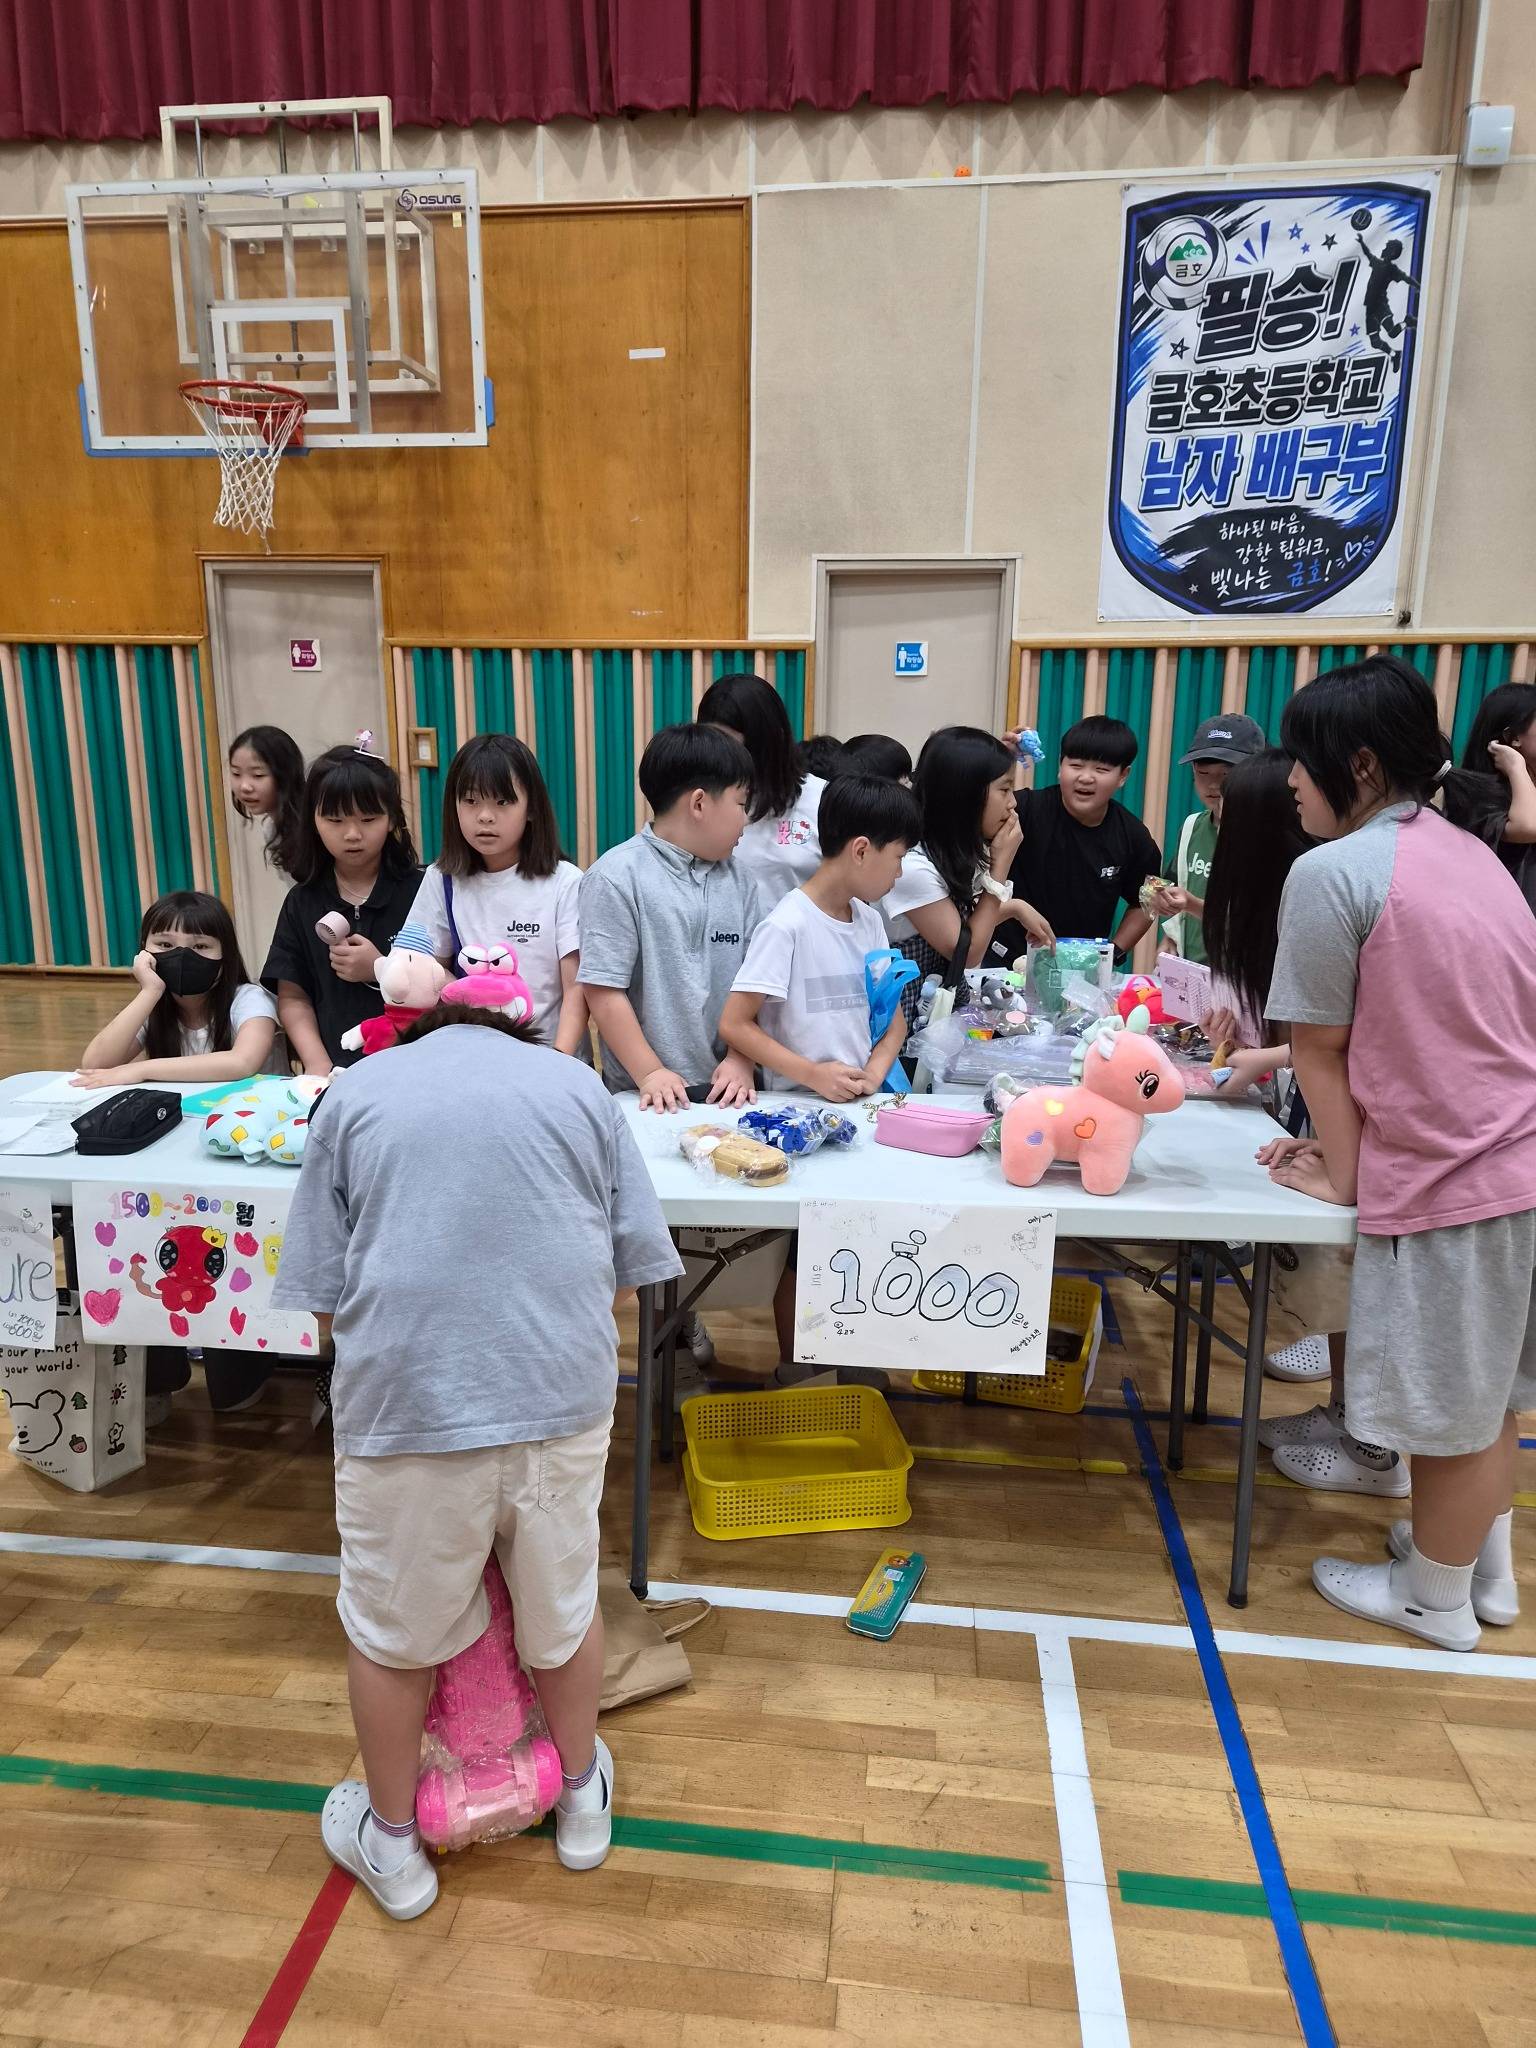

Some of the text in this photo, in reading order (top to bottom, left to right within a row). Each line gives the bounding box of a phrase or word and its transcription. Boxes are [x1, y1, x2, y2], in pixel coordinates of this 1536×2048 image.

[1175, 263, 1203, 278] 금호
[1195, 257, 1359, 362] 필승!
[1147, 355, 1388, 432] 금호초등학교
[1139, 417, 1392, 512] 남자 배구부
[1219, 512, 1305, 541] 하나된 마음,
[1236, 537, 1330, 565] 강한 팀워크,
[1211, 559, 1332, 599] 빛나는 금호!
[1188, 852, 1211, 878] Jee
[507, 919, 540, 935] Jeep
[711, 931, 740, 945] Jeep
[829, 1249, 1020, 1328] 1000
[8, 1349, 28, 1357] our
[35, 1341, 78, 1357] pnet
[5, 1366, 28, 1378] your
